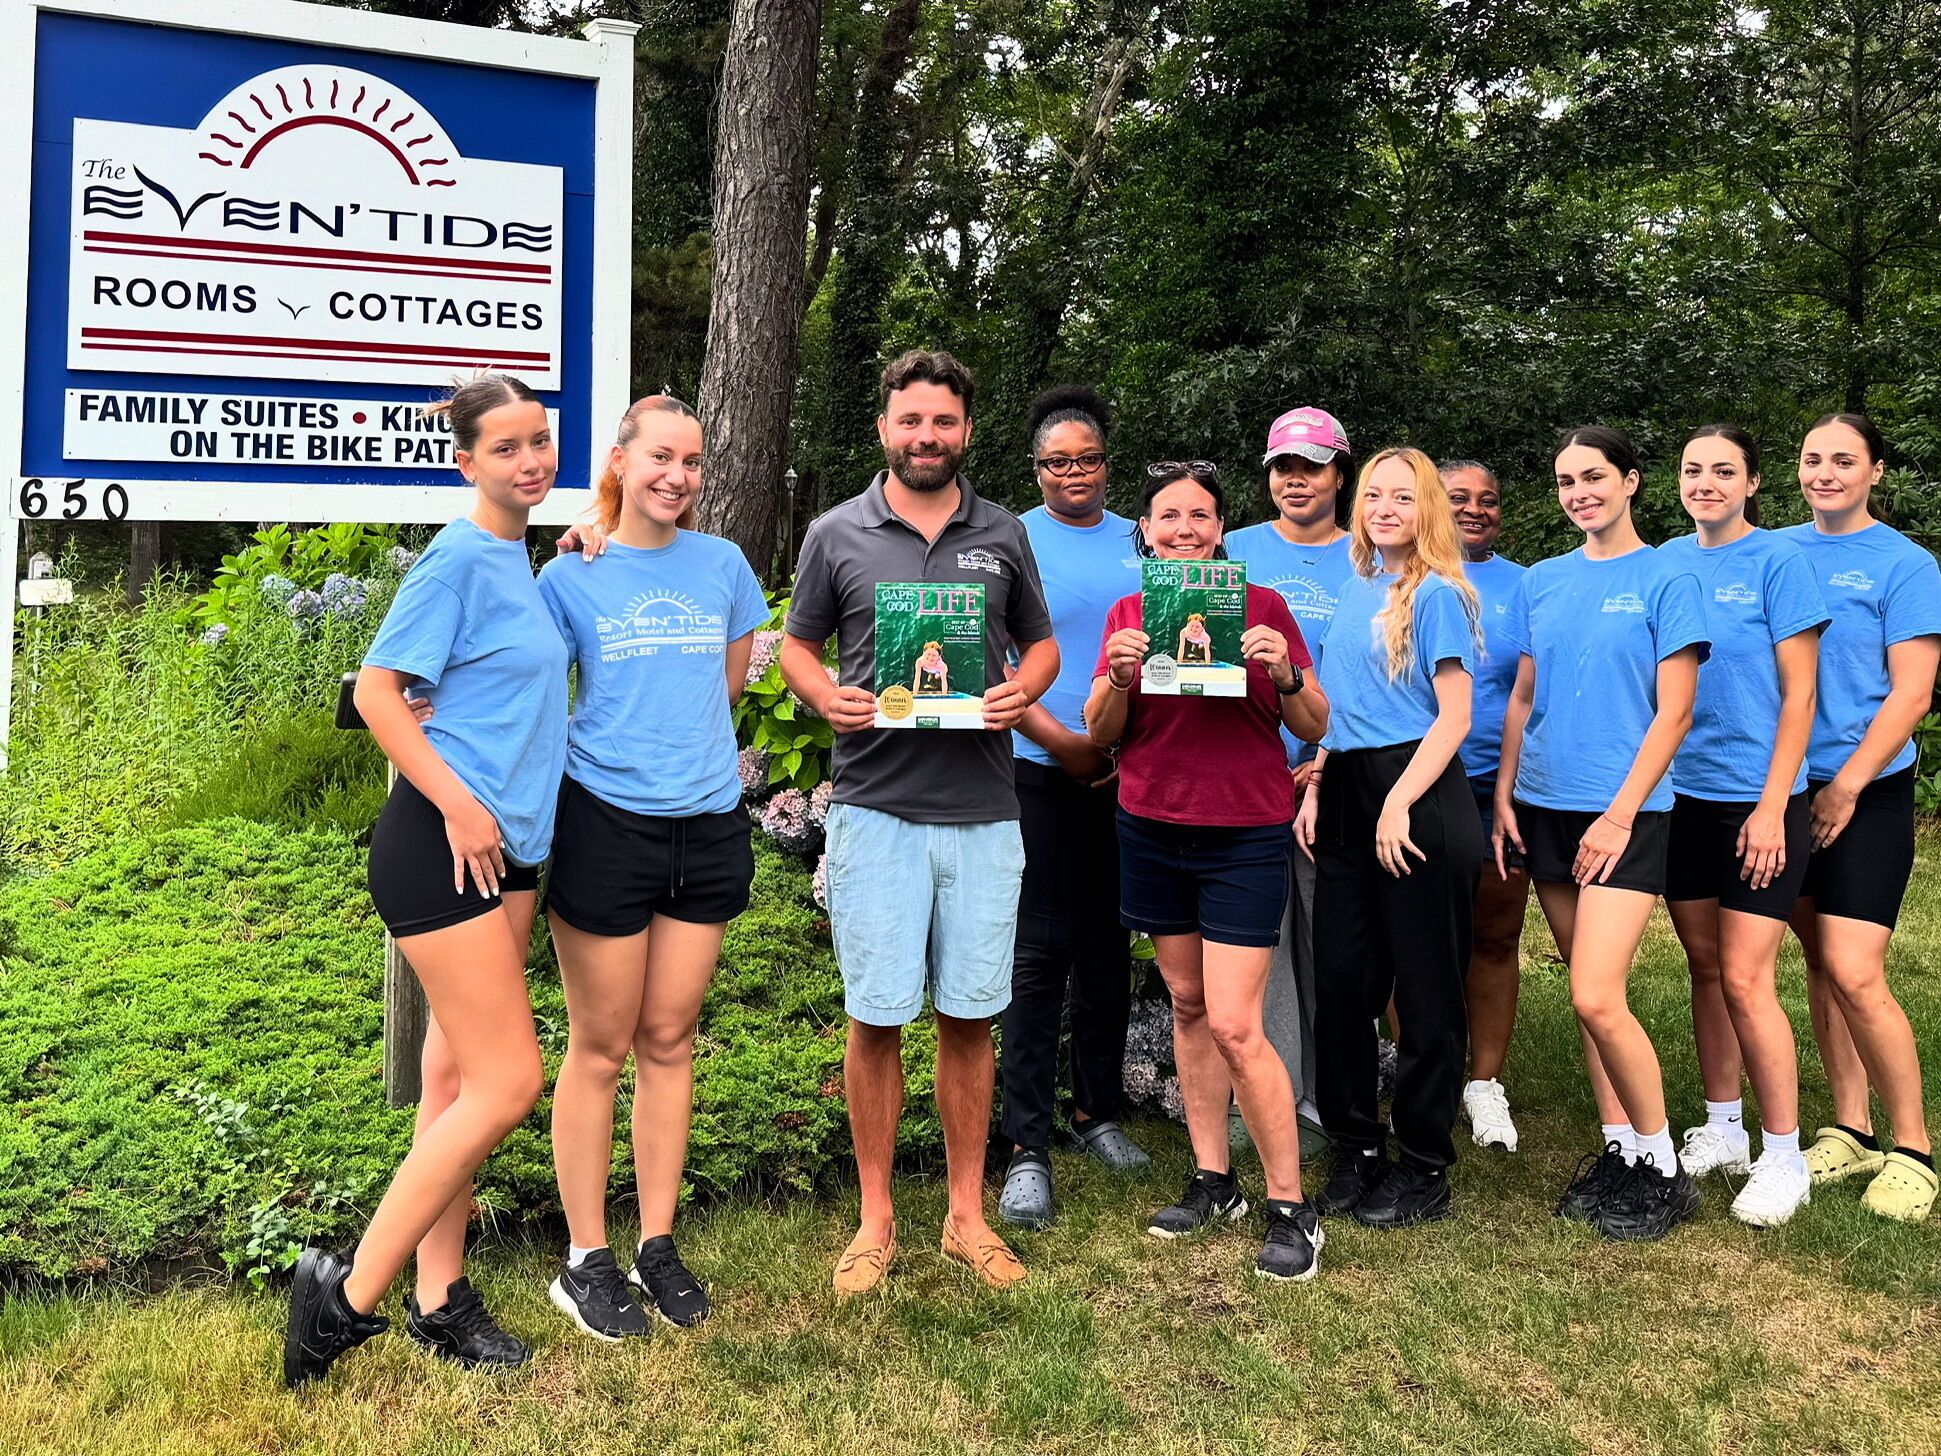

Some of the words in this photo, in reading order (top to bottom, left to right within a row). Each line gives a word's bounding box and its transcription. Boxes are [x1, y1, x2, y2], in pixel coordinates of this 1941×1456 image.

[82, 159, 125, 181] The
[93, 275, 258, 315] ROOMS
[328, 290, 544, 331] COTTAGES
[80, 394, 209, 426] FAMILY
[220, 399, 339, 430] SUITES
[170, 430, 218, 458] ON
[231, 432, 296, 461] THE
[307, 434, 382, 462] BIKE
[20, 478, 129, 520] 650
[1147, 565, 1178, 575] CAPE
[1152, 576, 1179, 586] COD
[1182, 565, 1242, 588] LIFE
[881, 589, 914, 601] CAPE
[917, 590, 980, 613] LIFE
[886, 602, 914, 612] COD
[600, 630, 632, 643] Resort
[636, 627, 664, 635] Motel
[666, 627, 686, 635] and
[601, 646, 659, 663] WELLFLEET
[681, 645, 708, 654] CAPE
